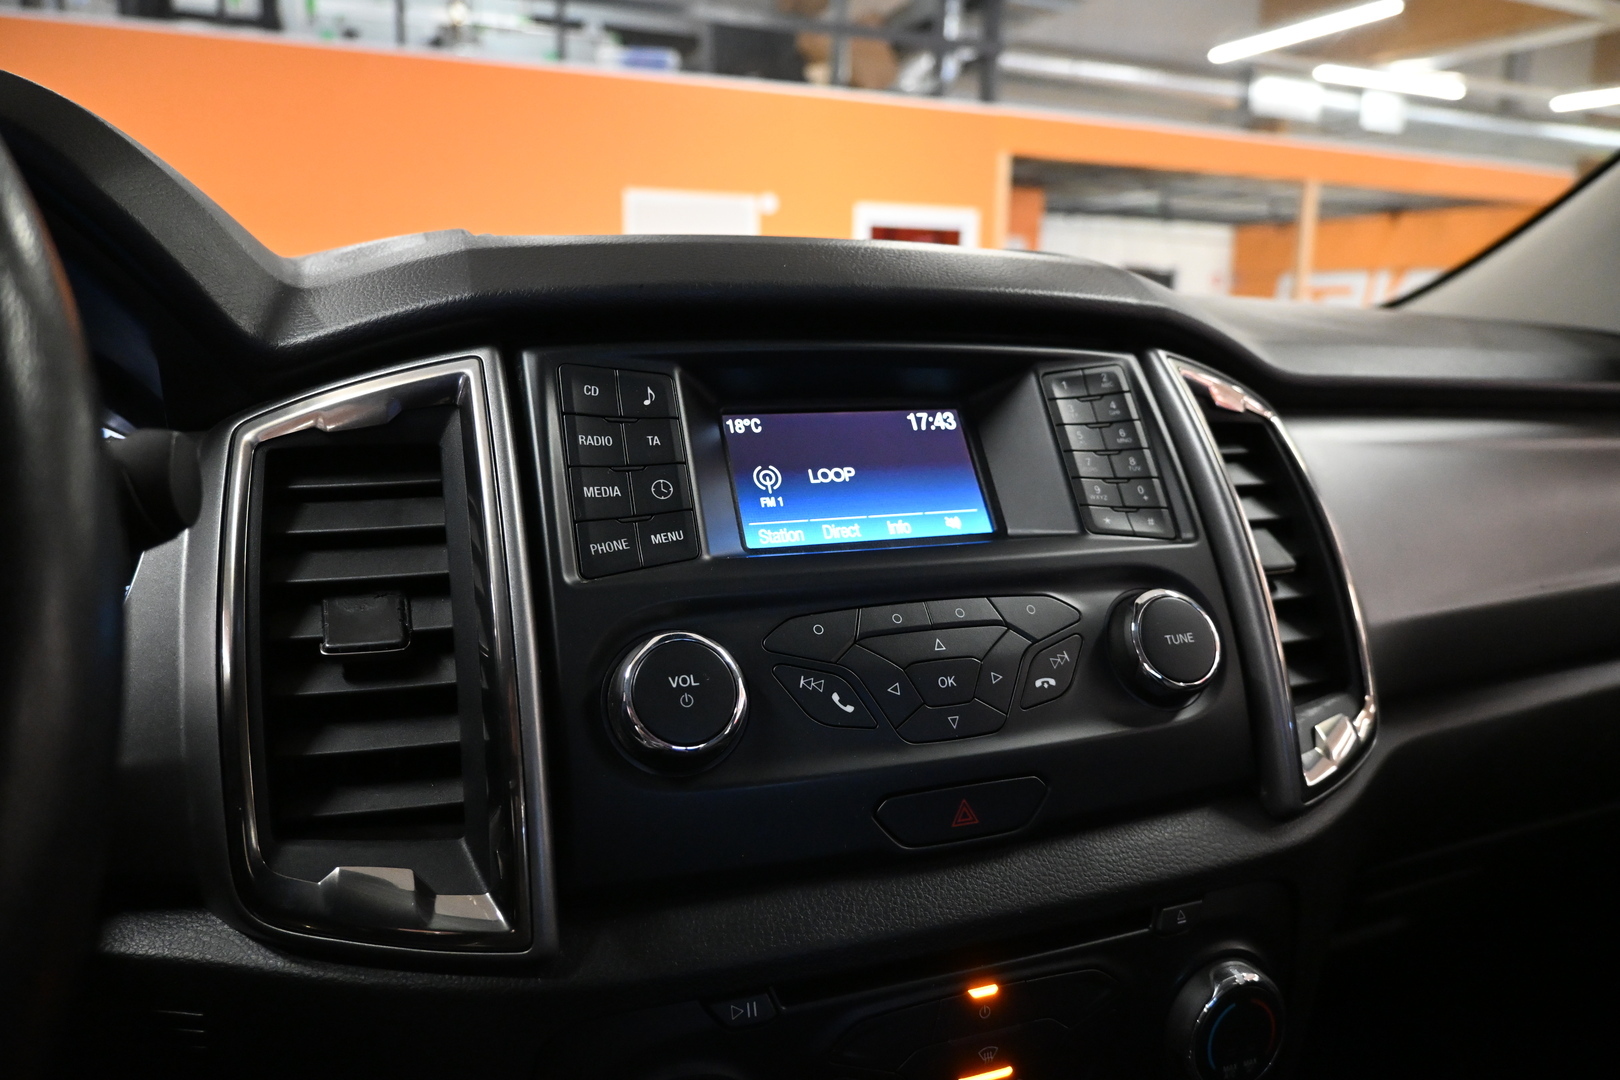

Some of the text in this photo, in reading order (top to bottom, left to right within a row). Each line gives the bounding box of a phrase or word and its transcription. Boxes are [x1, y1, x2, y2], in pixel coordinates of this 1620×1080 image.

[1100, 373, 1108, 382] 2
[583, 384, 599, 397] CD
[1061, 381, 1068, 390] 1
[1067, 404, 1075, 413] 3
[1109, 401, 1117, 410] 4
[906, 411, 957, 431] 17:43
[1076, 431, 1084, 440] 5
[1118, 428, 1126, 438] 6
[578, 434, 613, 447] RADIO
[646, 435, 661, 446] TA
[1086, 457, 1092, 466] 7
[1128, 457, 1136, 466] 8
[807, 466, 855, 484] LOOP
[583, 486, 622, 498] MEDIA
[1094, 485, 1101, 494] 9
[1137, 485, 1145, 495] 0
[759, 496, 784, 508] FM 1
[821, 523, 861, 540] Direct
[886, 519, 912, 536] Info
[650, 529, 684, 545] MENU
[758, 528, 805, 545] Station
[589, 538, 630, 555] PHONE
[1163, 632, 1195, 645] TUNE
[668, 674, 700, 688] VOL
[937, 675, 957, 689] OK
